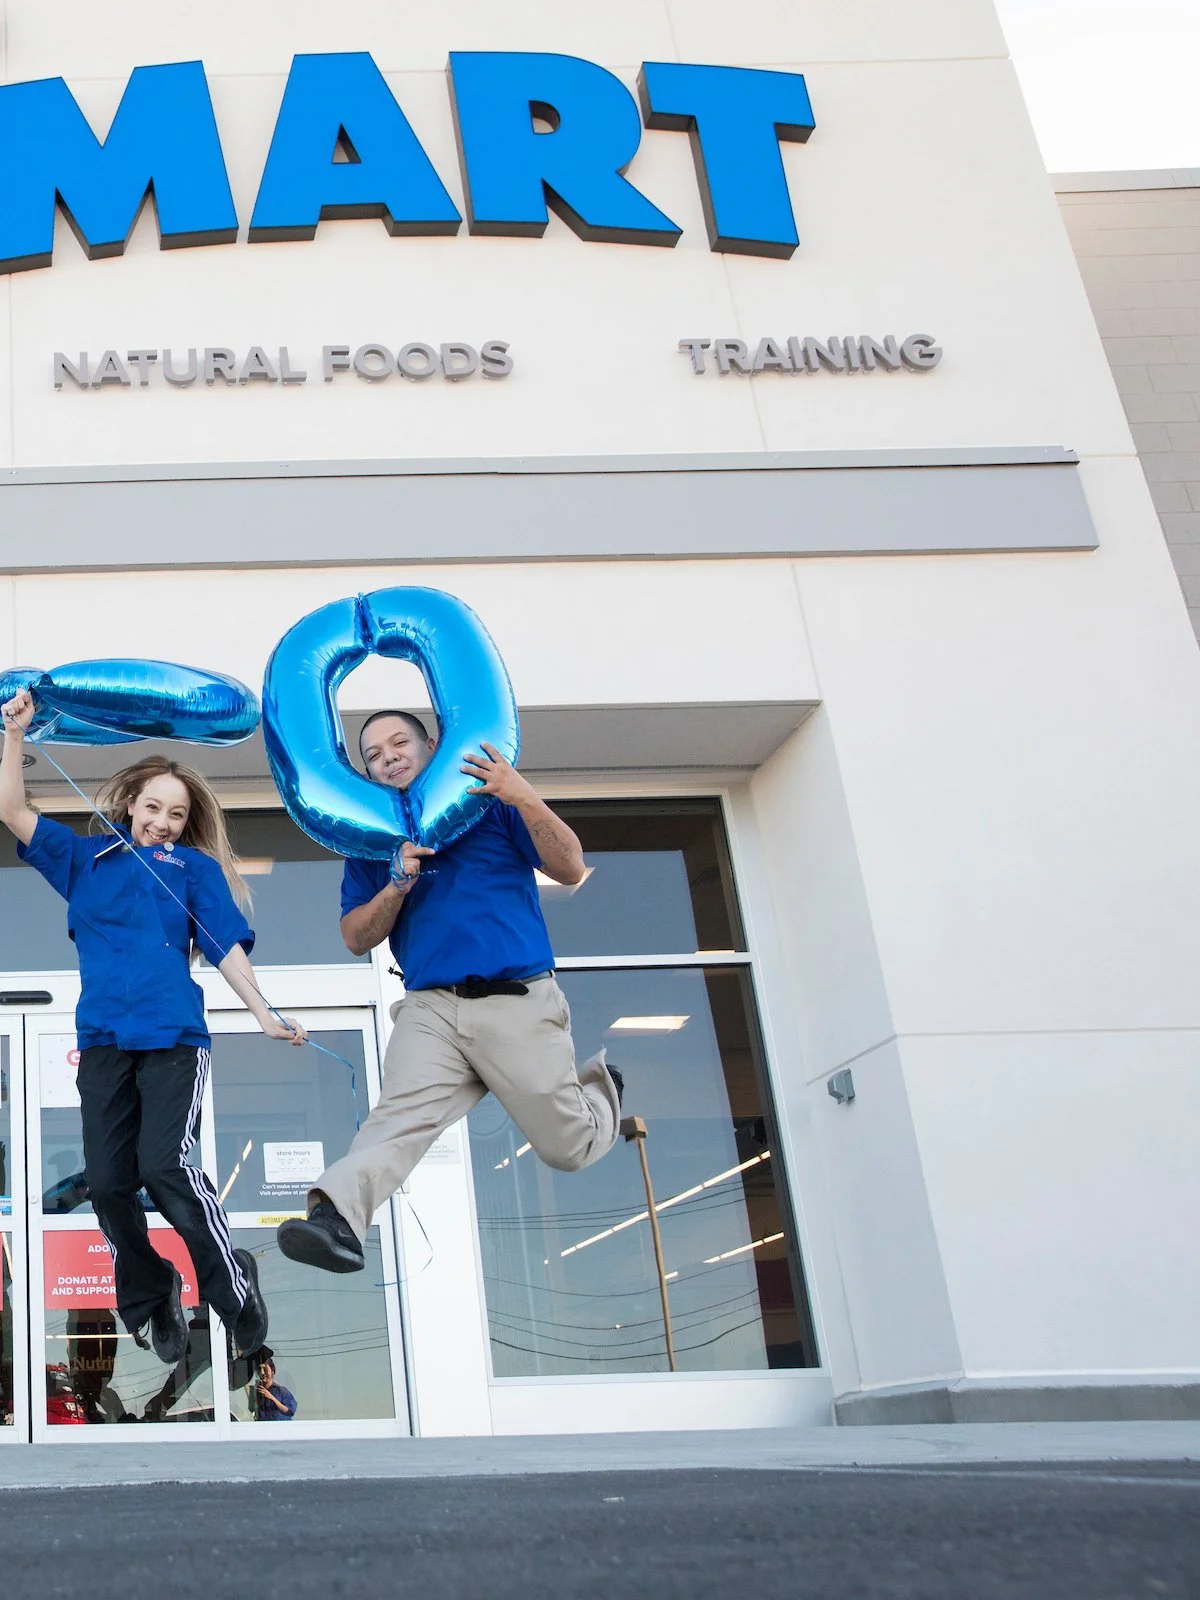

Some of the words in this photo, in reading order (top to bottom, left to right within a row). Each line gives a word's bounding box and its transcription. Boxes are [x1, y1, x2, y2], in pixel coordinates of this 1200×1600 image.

[53, 344, 308, 390] NATURAL
[322, 340, 515, 384] FOODS
[678, 333, 944, 376] TRAINING
[51, 1287, 74, 1296] AND
[76, 1286, 117, 1295] SUPPOR
[57, 1276, 98, 1285] DONATE
[100, 1275, 113, 1284] AT
